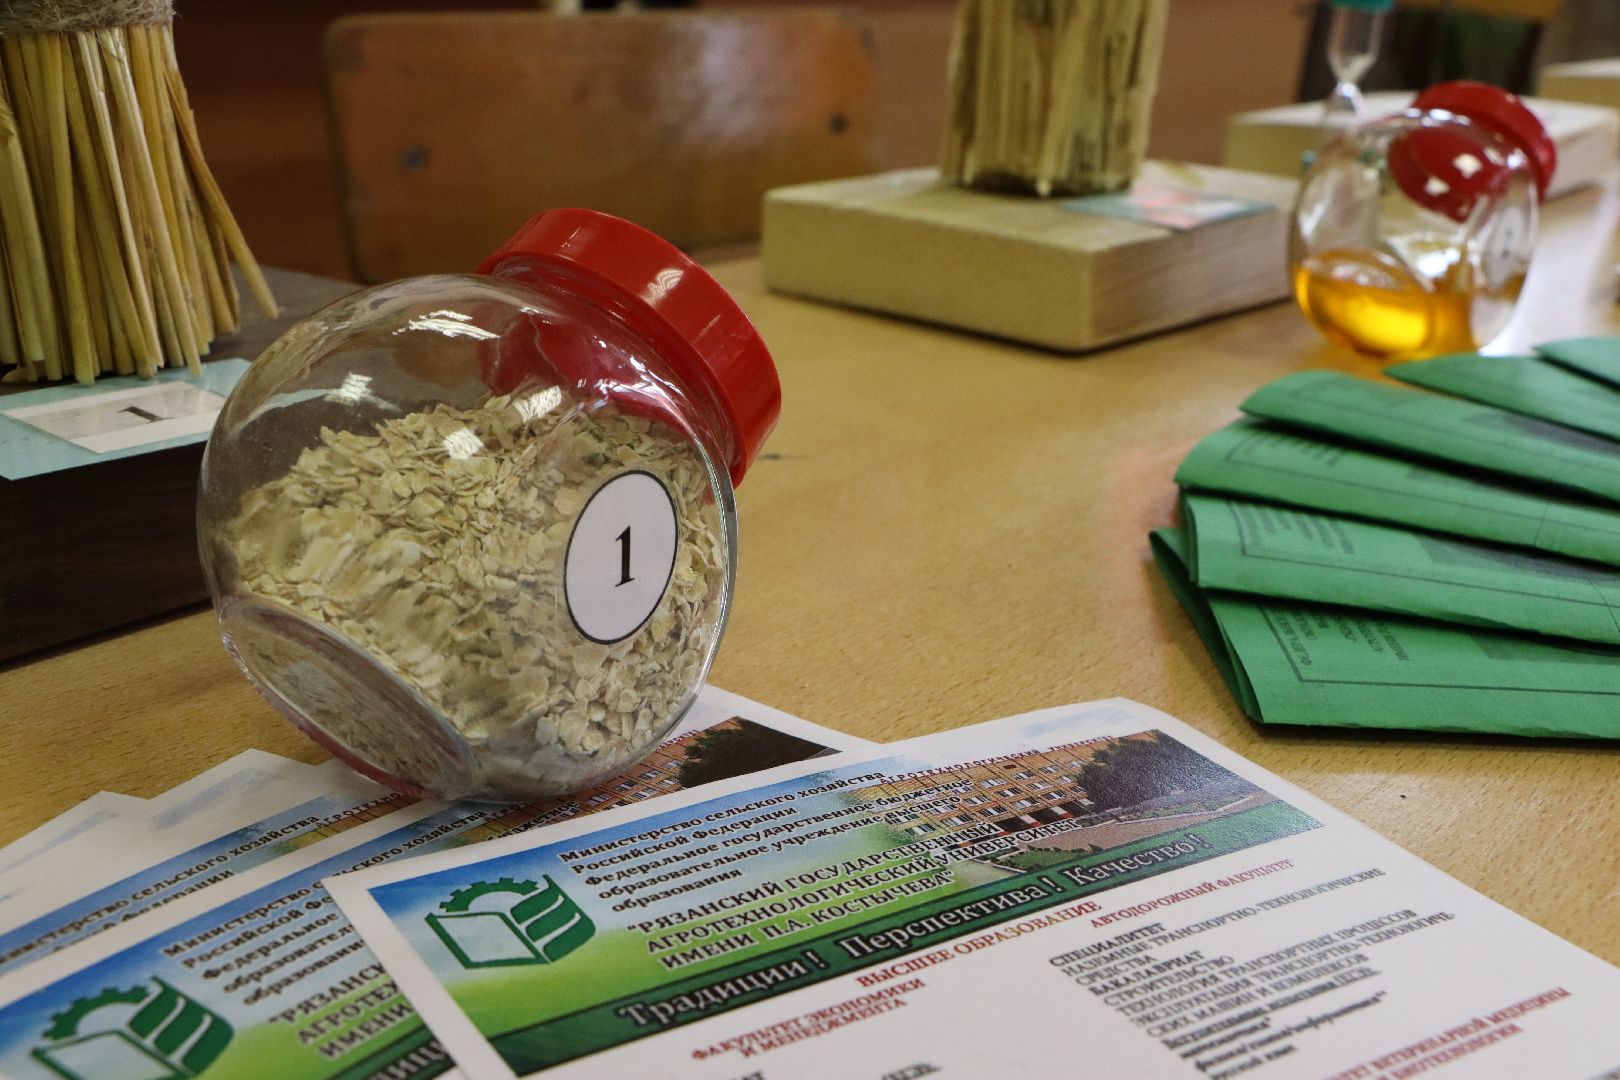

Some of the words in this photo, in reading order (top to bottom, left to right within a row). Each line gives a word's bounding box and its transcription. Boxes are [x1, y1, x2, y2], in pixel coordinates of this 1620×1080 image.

[615, 526, 635, 587] 1
[559, 818, 703, 863] Министерство
[704, 793, 796, 824] сельского
[800, 771, 887, 799] хозяйства
[571, 835, 691, 875] Российской
[692, 807, 798, 841] Федерации
[585, 844, 720, 886] Федеральное
[721, 803, 874, 848] государственное
[874, 779, 974, 808] бюджетное
[599, 844, 769, 900] образовательное
[771, 815, 885, 852] учреждение
[885, 795, 962, 821] высшего
[131, 854, 229, 900] сельского
[229, 813, 322, 858] хозяйства
[163, 888, 311, 957] Министерство
[402, 809, 487, 851] хозяйства
[647, 857, 937, 953] АГРОТЕХНОЛОГИЧЕСКИЙ
[937, 818, 1081, 866] УНИВЕРСИТЕТ
[785, 822, 1003, 889] ГОСУДАРСТВЕННЫЙ
[611, 869, 743, 913] образования
[1090, 882, 1217, 929] АВТОДОРОЖНЫЙ
[1216, 859, 1295, 888] ФАКУЛЬТЕТ
[182, 909, 304, 969] Российской
[203, 911, 339, 981] Федеральное
[660, 934, 757, 970] ИМЕНИ
[855, 948, 954, 988] ВЫСШЕЕ
[954, 899, 1102, 955] ОБРАЗОВАНИЕ
[1049, 923, 1167, 968] СПЕЦИАЛИТЕТ
[1061, 939, 1155, 977] НАЗЕМНЫЕ
[1075, 954, 1157, 987] СРЕДСТВА
[1088, 950, 1206, 996] БАКАЛАВРИАТ
[1102, 955, 1235, 1007] СТРОИТЕЛЬСТВО
[318, 1002, 414, 1060] ИМЕНИ
[692, 1016, 801, 1060] ФАКУЛЬТЕТ
[803, 978, 926, 1022] ЭКОНОМИКИ
